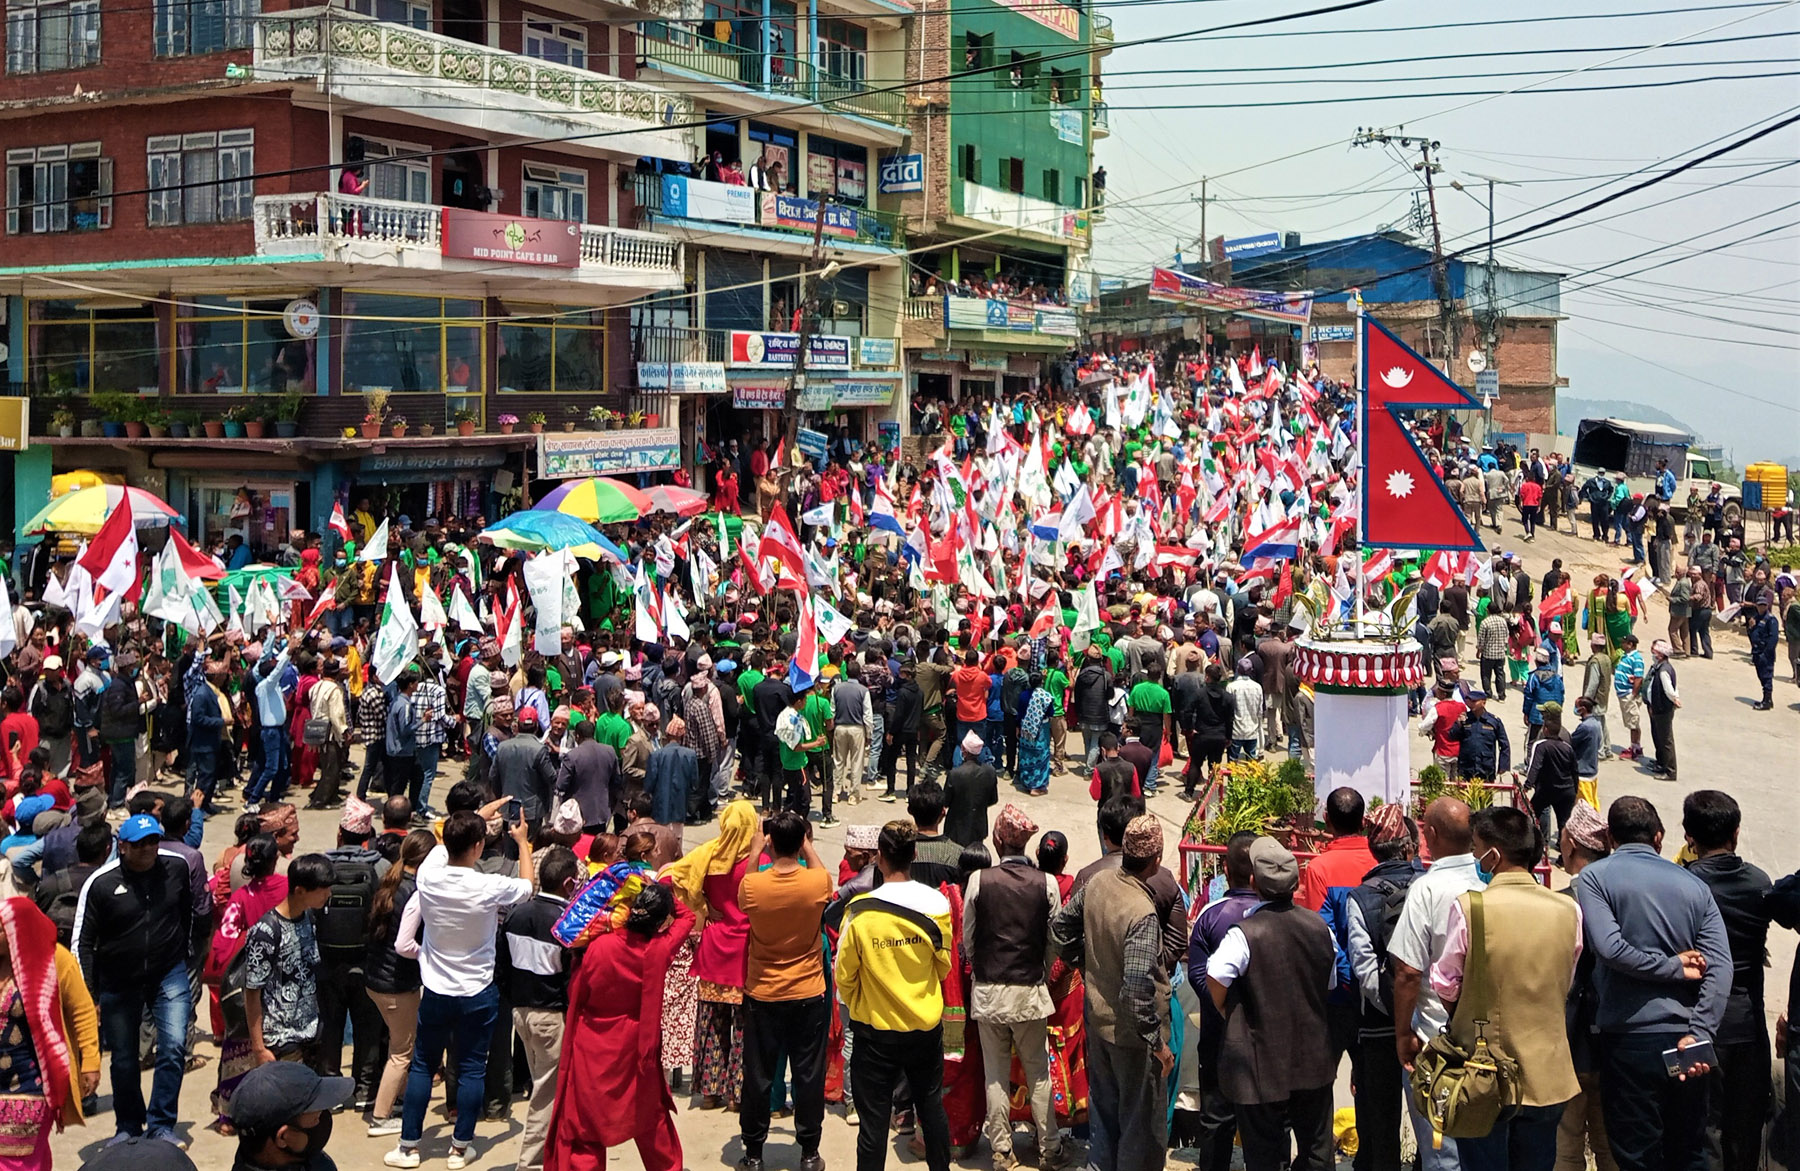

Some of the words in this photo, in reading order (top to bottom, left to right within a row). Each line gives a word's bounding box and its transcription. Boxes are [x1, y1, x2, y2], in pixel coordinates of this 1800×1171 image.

[1034, 0, 1078, 34] JAPAN
[882, 156, 919, 183] दाँत
[726, 189, 751, 199] PREMIER
[473, 247, 489, 257] MID
[490, 248, 514, 260] POINT
[516, 251, 535, 261] CAFE
[543, 254, 558, 263] BAR
[827, 355, 846, 364] LIMITED
